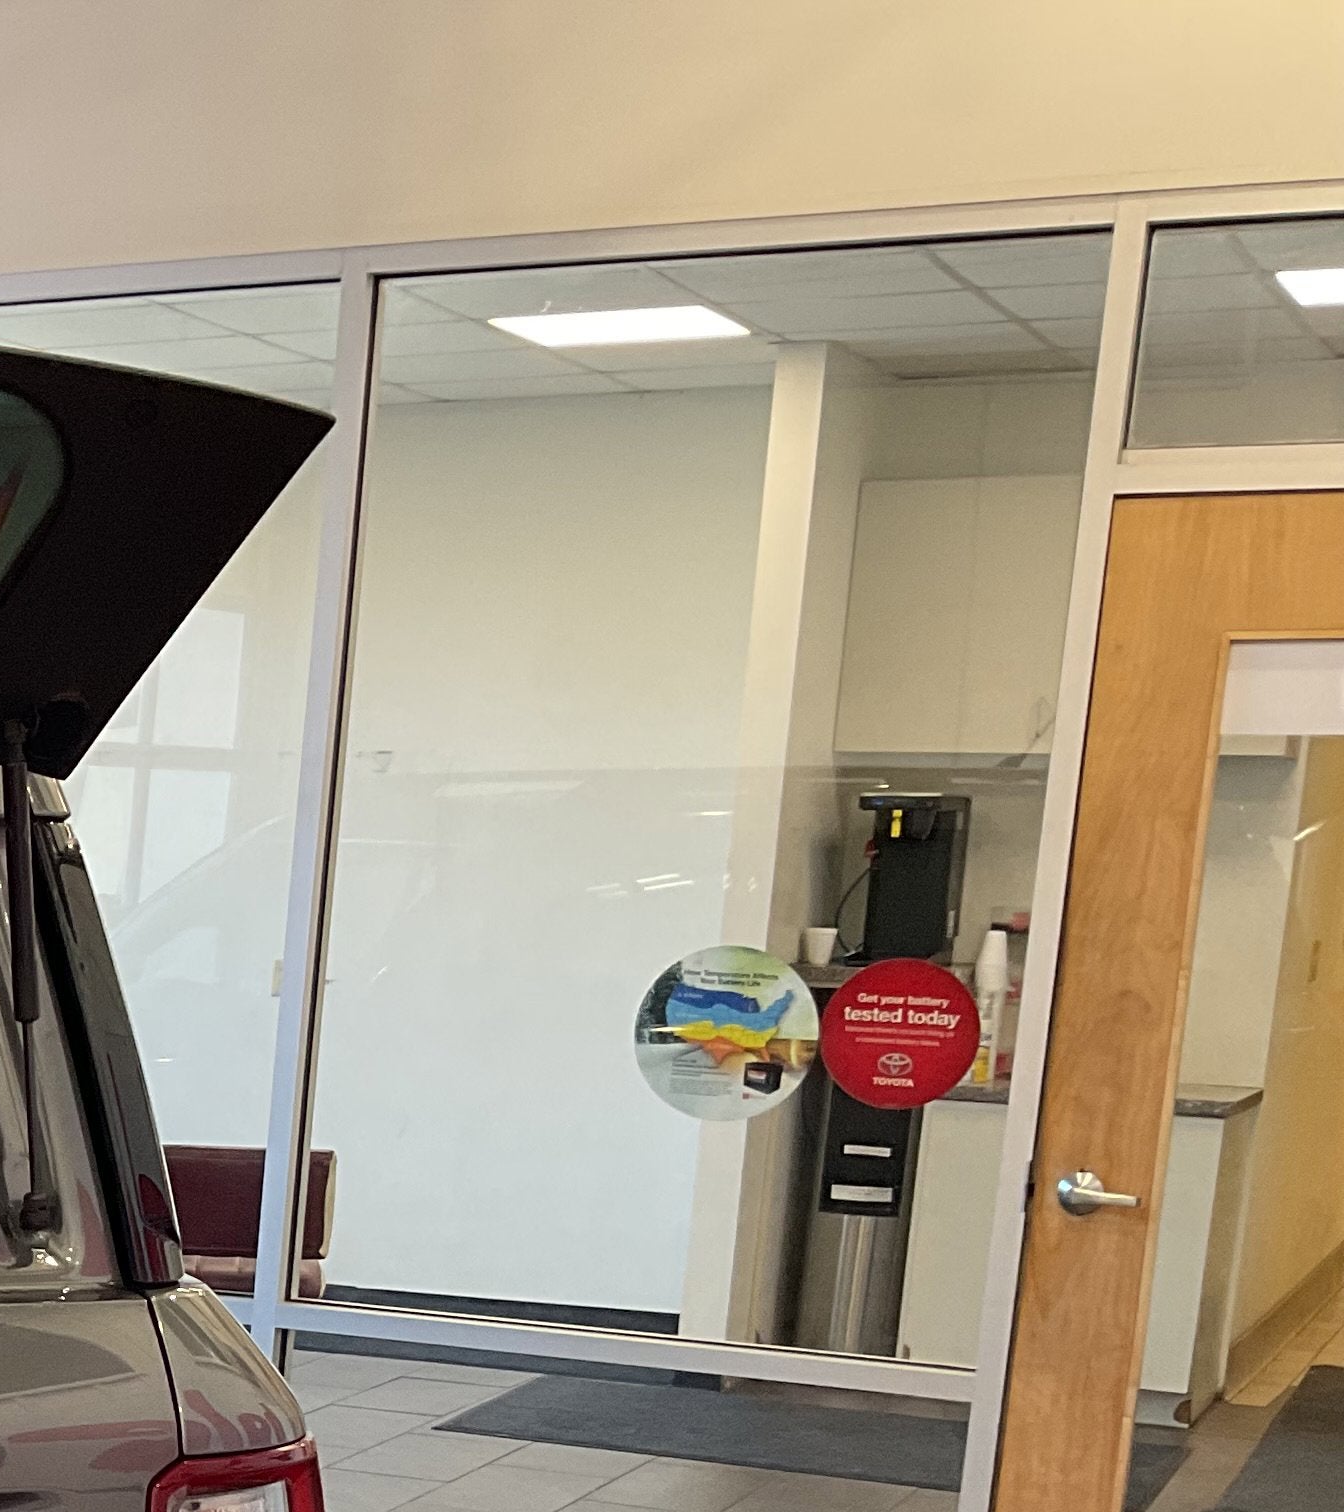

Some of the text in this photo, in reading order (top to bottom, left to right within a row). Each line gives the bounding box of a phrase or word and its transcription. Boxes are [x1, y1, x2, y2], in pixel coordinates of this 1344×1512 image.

[857, 993, 951, 1009] Get your battery
[843, 1006, 961, 1029] tested today
[872, 1076, 915, 1088] TOYOTA
